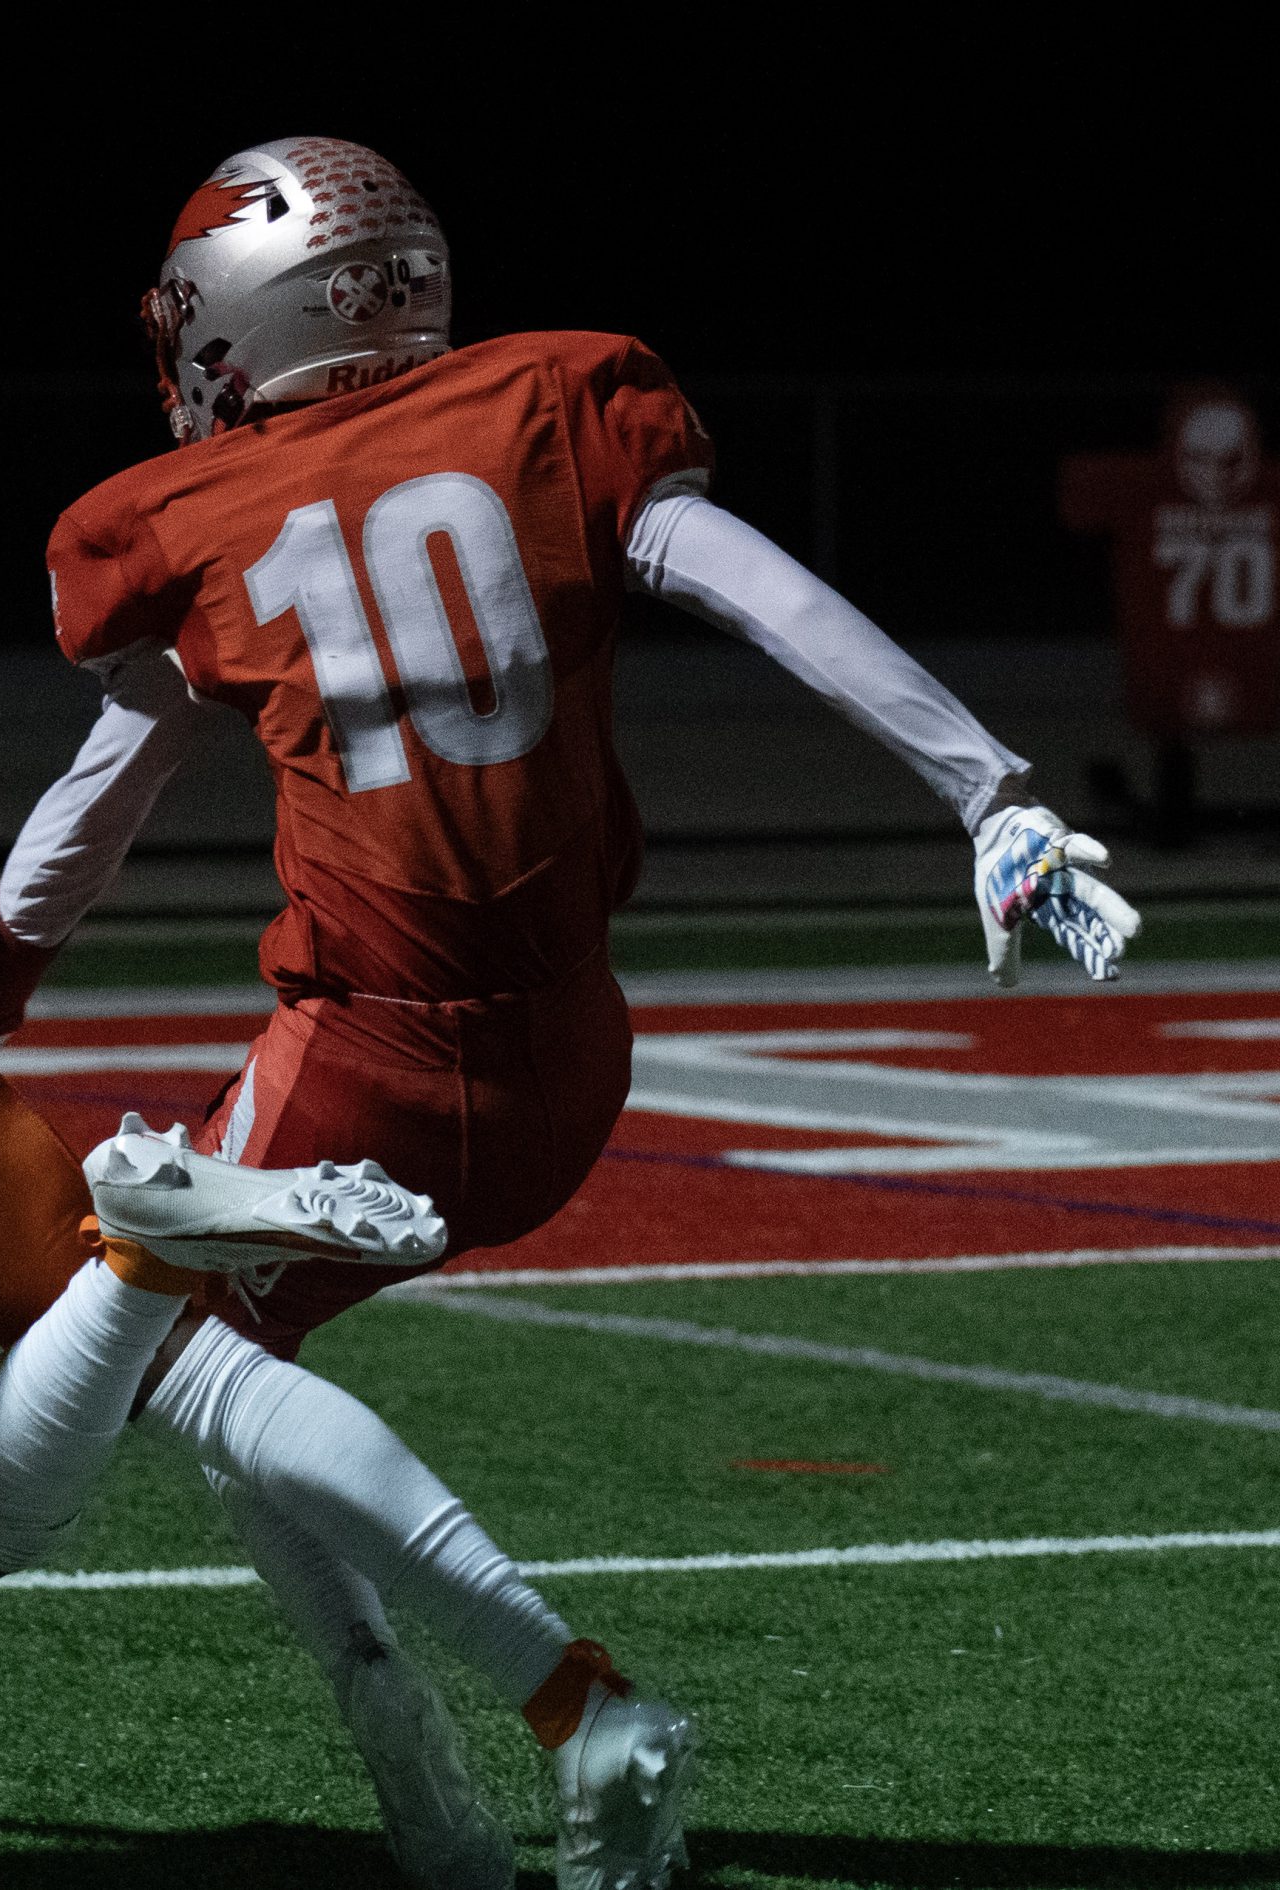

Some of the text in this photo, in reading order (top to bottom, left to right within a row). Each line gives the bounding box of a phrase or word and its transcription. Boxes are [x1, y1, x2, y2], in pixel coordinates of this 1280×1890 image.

[384, 258, 410, 286] 10
[1154, 540, 1274, 628] 70
[243, 472, 554, 793] 10
